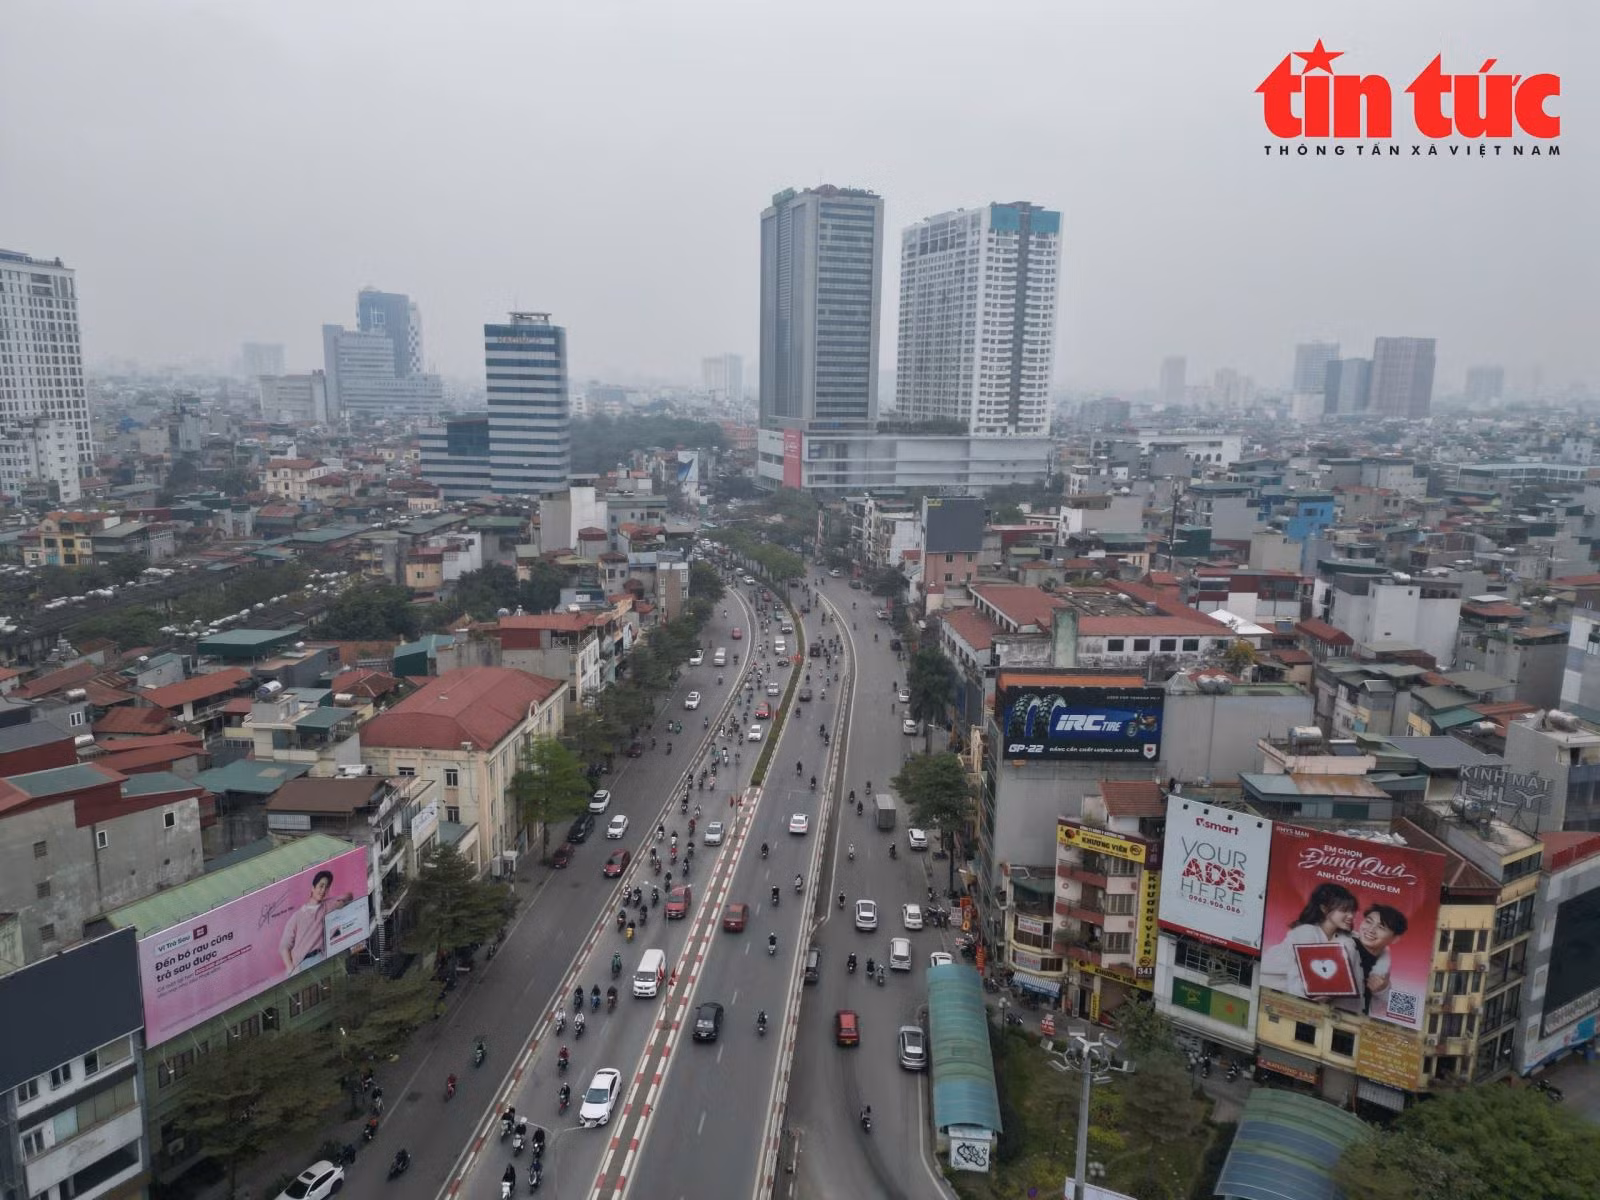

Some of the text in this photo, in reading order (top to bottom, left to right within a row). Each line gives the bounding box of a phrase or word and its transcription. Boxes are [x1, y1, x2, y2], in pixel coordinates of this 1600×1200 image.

[1101, 722, 1122, 732] TIRE
[1008, 744, 1045, 753] GP-22
[1181, 836, 1248, 870] YOUR
[1324, 844, 1363, 858] EM CHỌN
[1182, 858, 1246, 894] ADS
[1316, 870, 1401, 894] ANH CHỌN ĐÚNG EM
[1181, 877, 1244, 905] HERE
[155, 931, 234, 971] Đến bó rau cũng
[157, 968, 172, 982] trả
[173, 962, 191, 975] sau
[193, 950, 217, 967] được
[1138, 967, 1153, 975] 341
